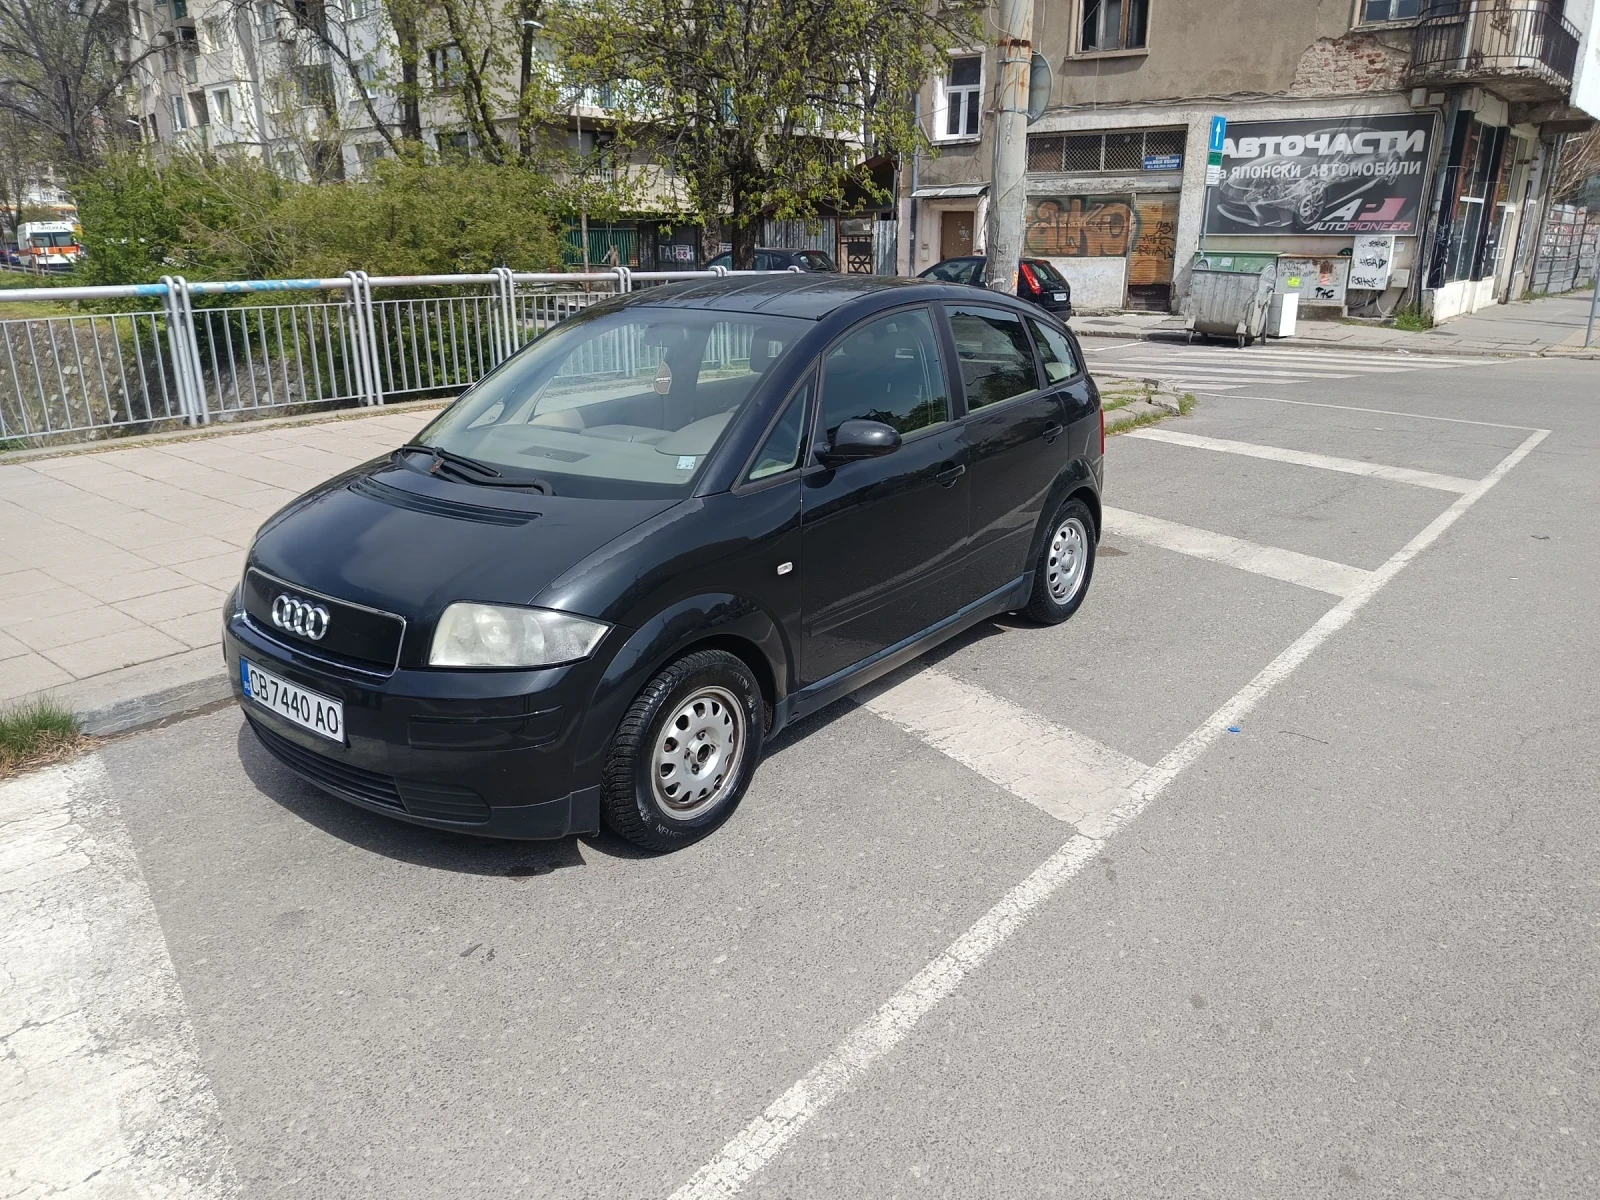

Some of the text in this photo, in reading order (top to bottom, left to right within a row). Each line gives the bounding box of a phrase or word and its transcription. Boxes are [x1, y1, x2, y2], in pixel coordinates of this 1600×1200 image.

[1222, 130, 1426, 158] АВТОЧАСТИ
[1231, 164, 1301, 179] ЯПОНСКИ
[1310, 160, 1421, 178] АВТОМОБИЛИ
[1305, 221, 1412, 231] AUTOPIONEER
[270, 679, 311, 723] 7440
